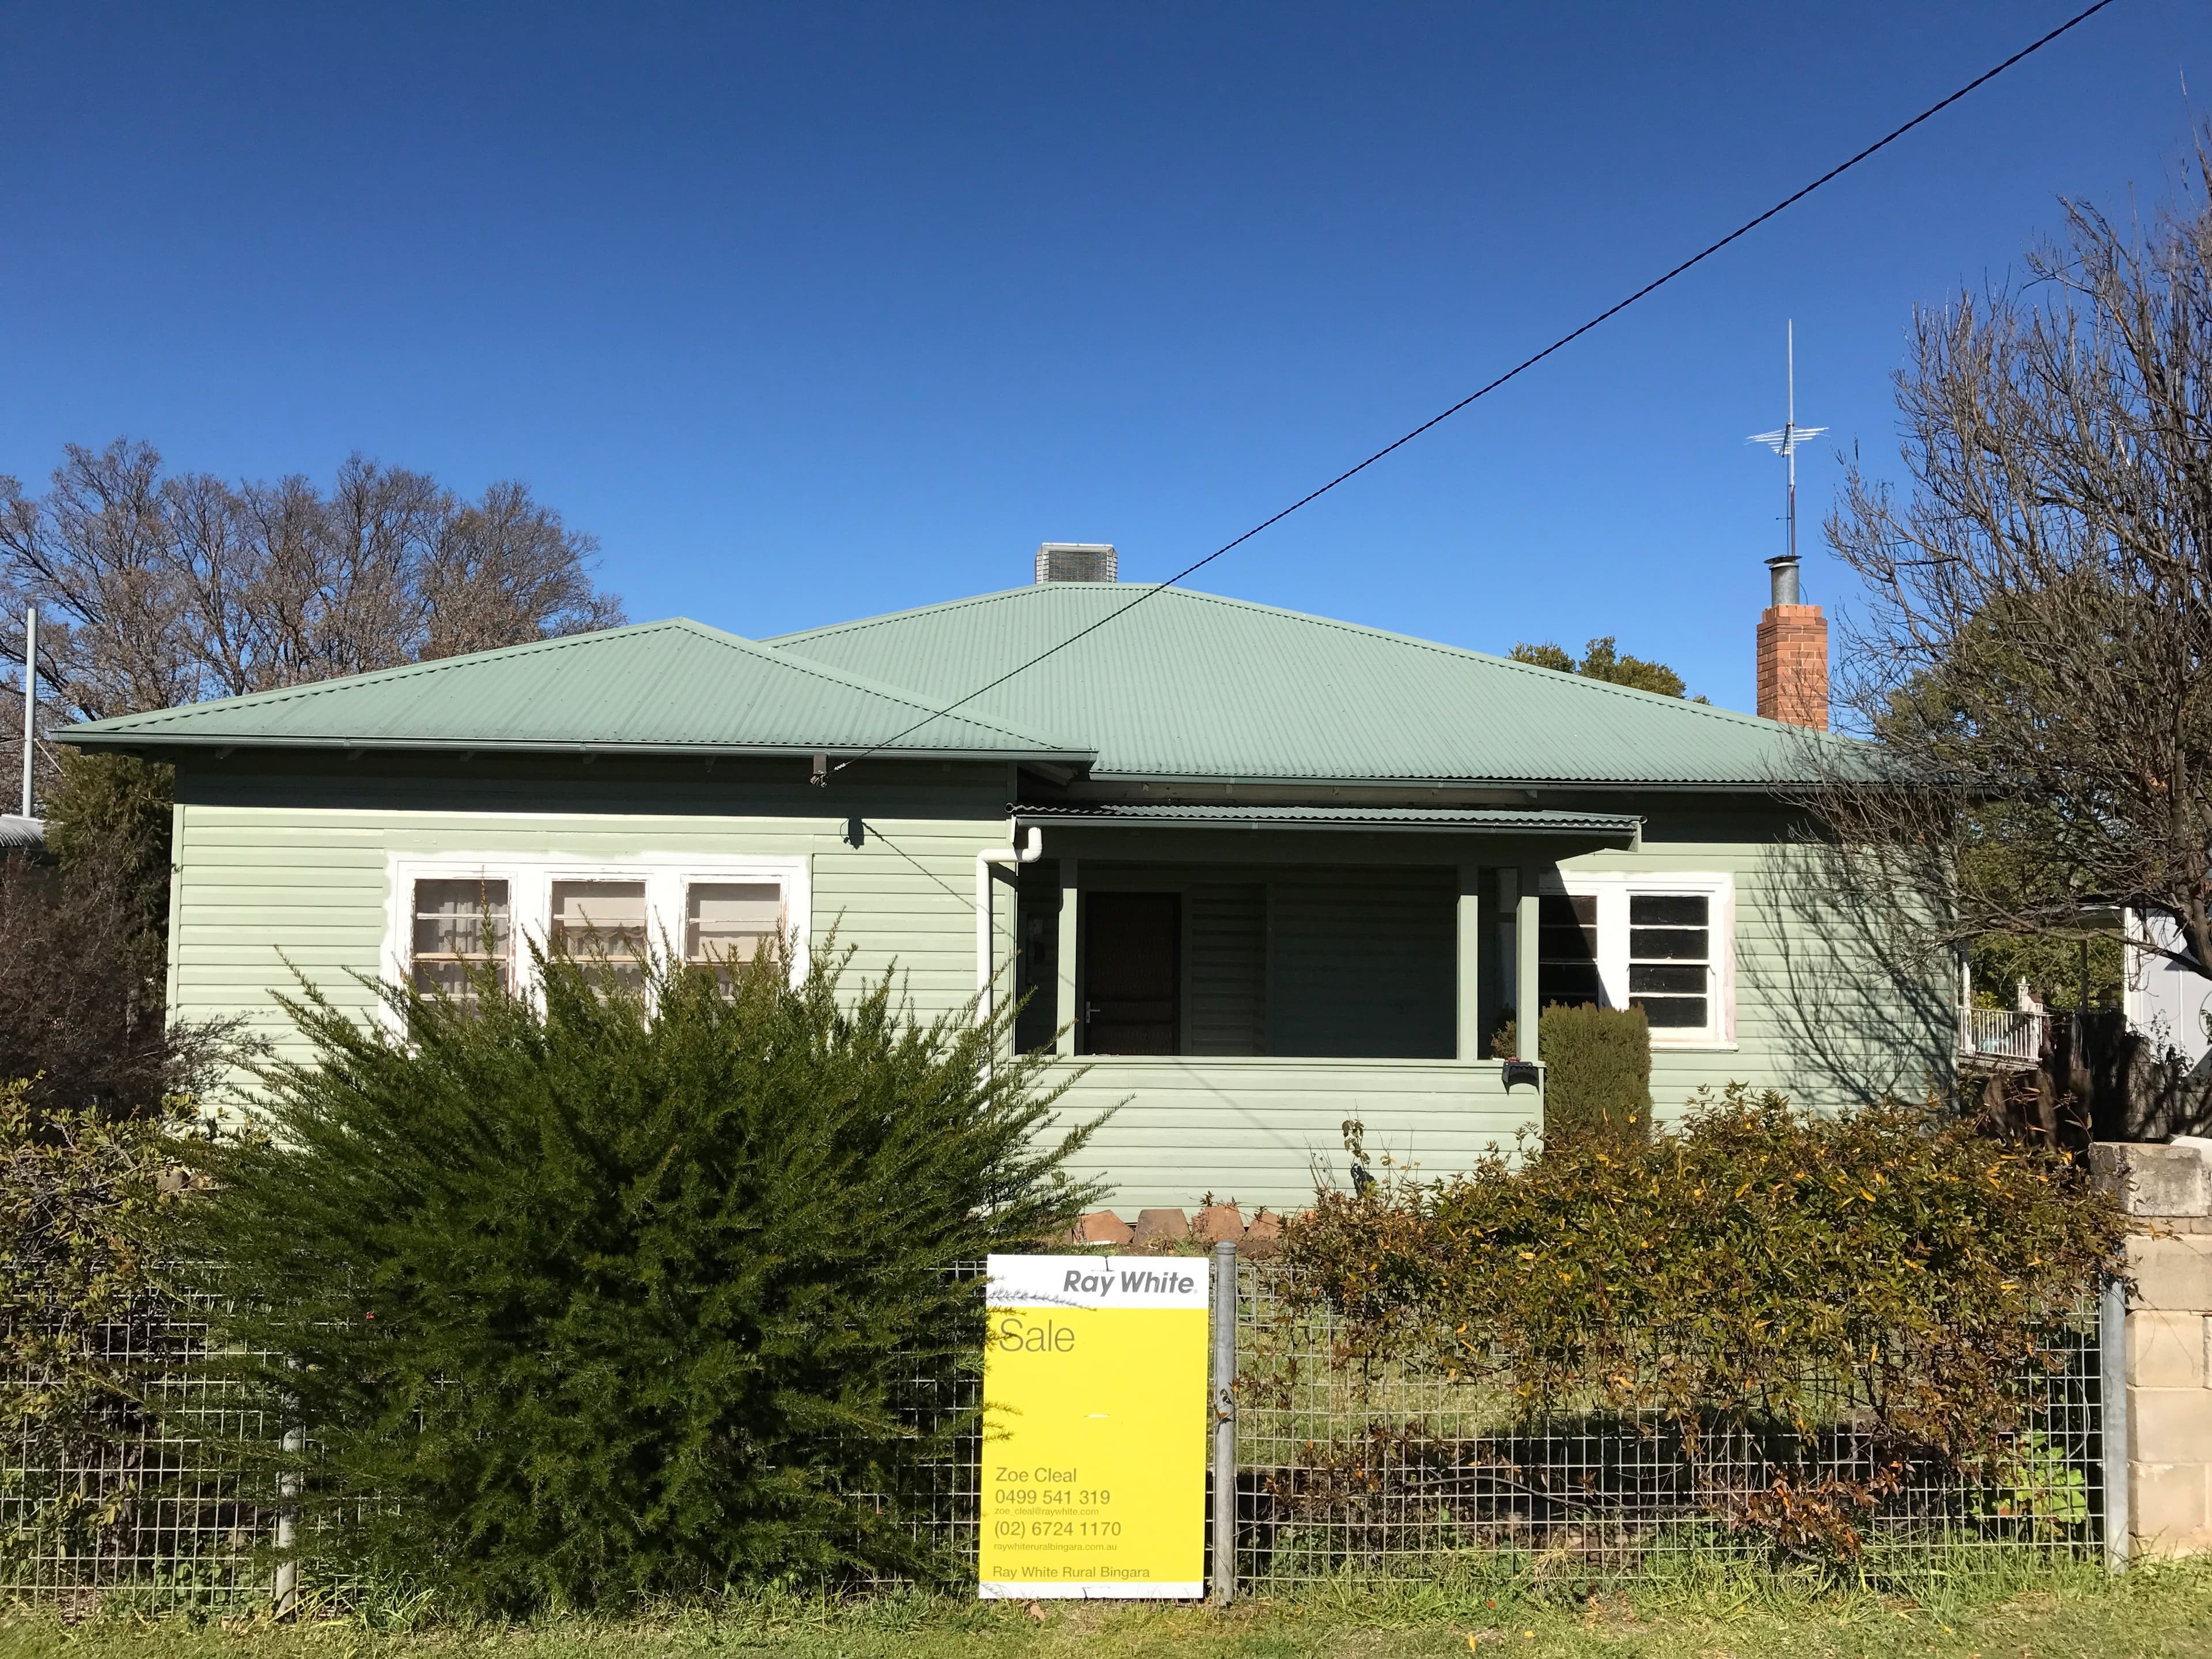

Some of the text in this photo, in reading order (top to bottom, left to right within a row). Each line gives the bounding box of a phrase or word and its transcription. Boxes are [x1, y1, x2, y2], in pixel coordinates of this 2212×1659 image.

[1063, 1270, 1194, 1297] Ray White
[999, 1318, 1075, 1352] Sale
[995, 1467, 1077, 1483] Zoe Cleal
[995, 1489, 1110, 1505] 0499 541 319
[994, 1508, 1099, 1517] zoe_cleal@raywhite.com
[994, 1521, 1121, 1539] (02) 6724 1170
[994, 1542, 1117, 1552] raywhiteruralbingara.com.au
[993, 1566, 1150, 1580] Ray White Rural Bingara
